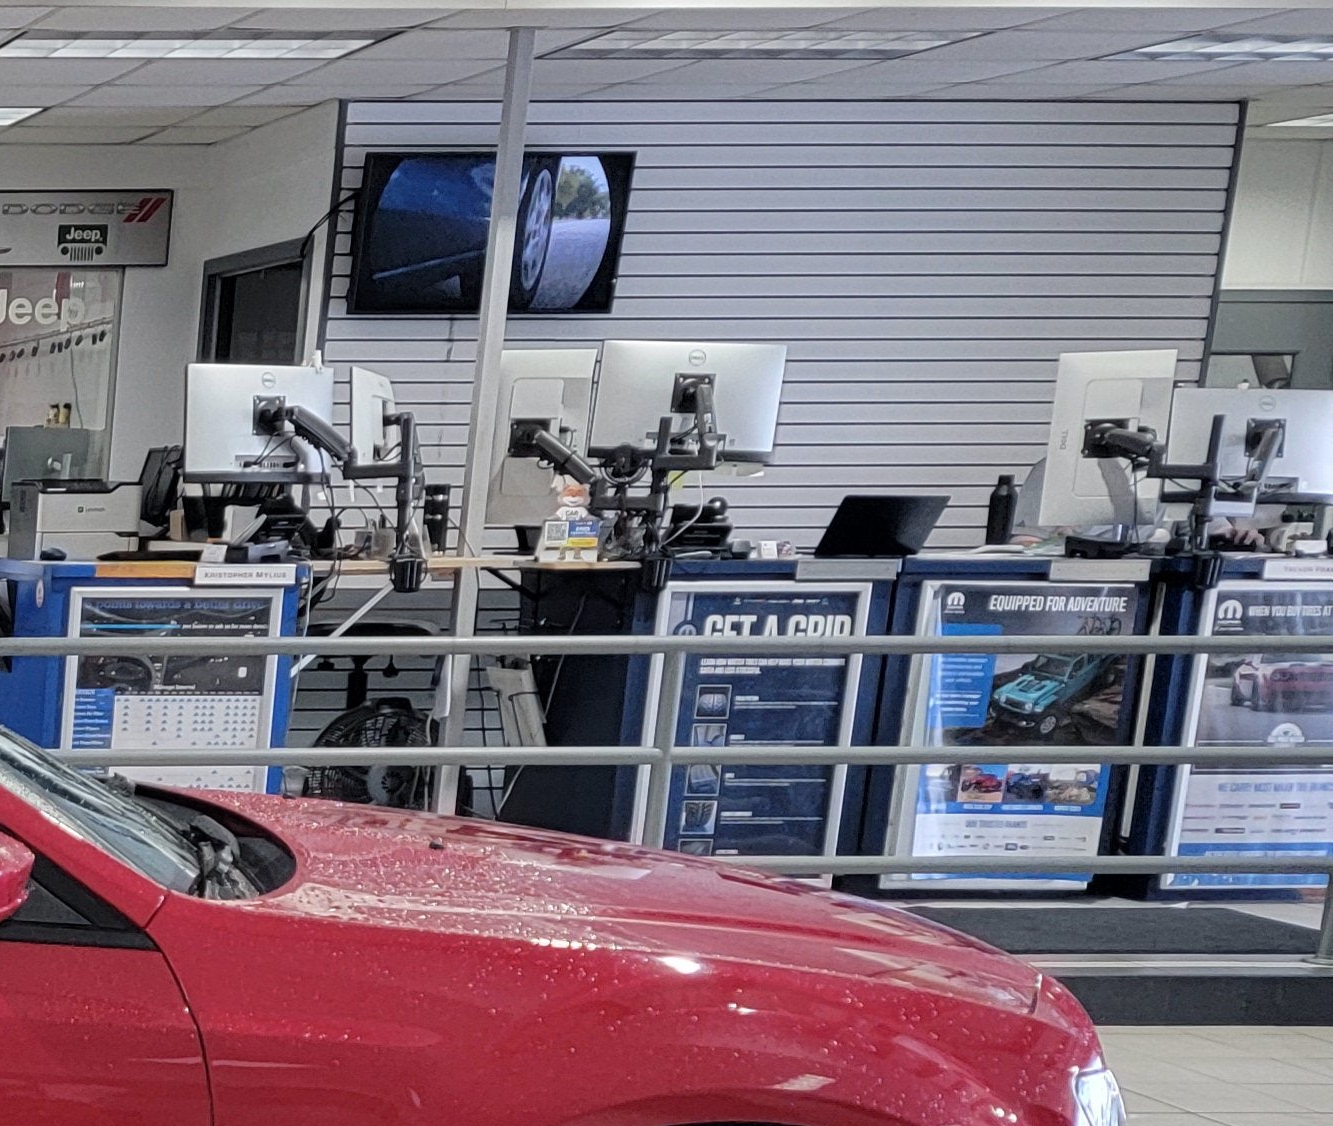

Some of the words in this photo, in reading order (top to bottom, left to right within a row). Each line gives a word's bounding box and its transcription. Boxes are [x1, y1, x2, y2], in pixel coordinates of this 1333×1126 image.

[989, 595, 1045, 611] EQUIPPED
[1046, 596, 1065, 611] FOR
[1067, 596, 1128, 612] ADVENTURE
[704, 614, 757, 636] GET
[763, 614, 779, 636] A
